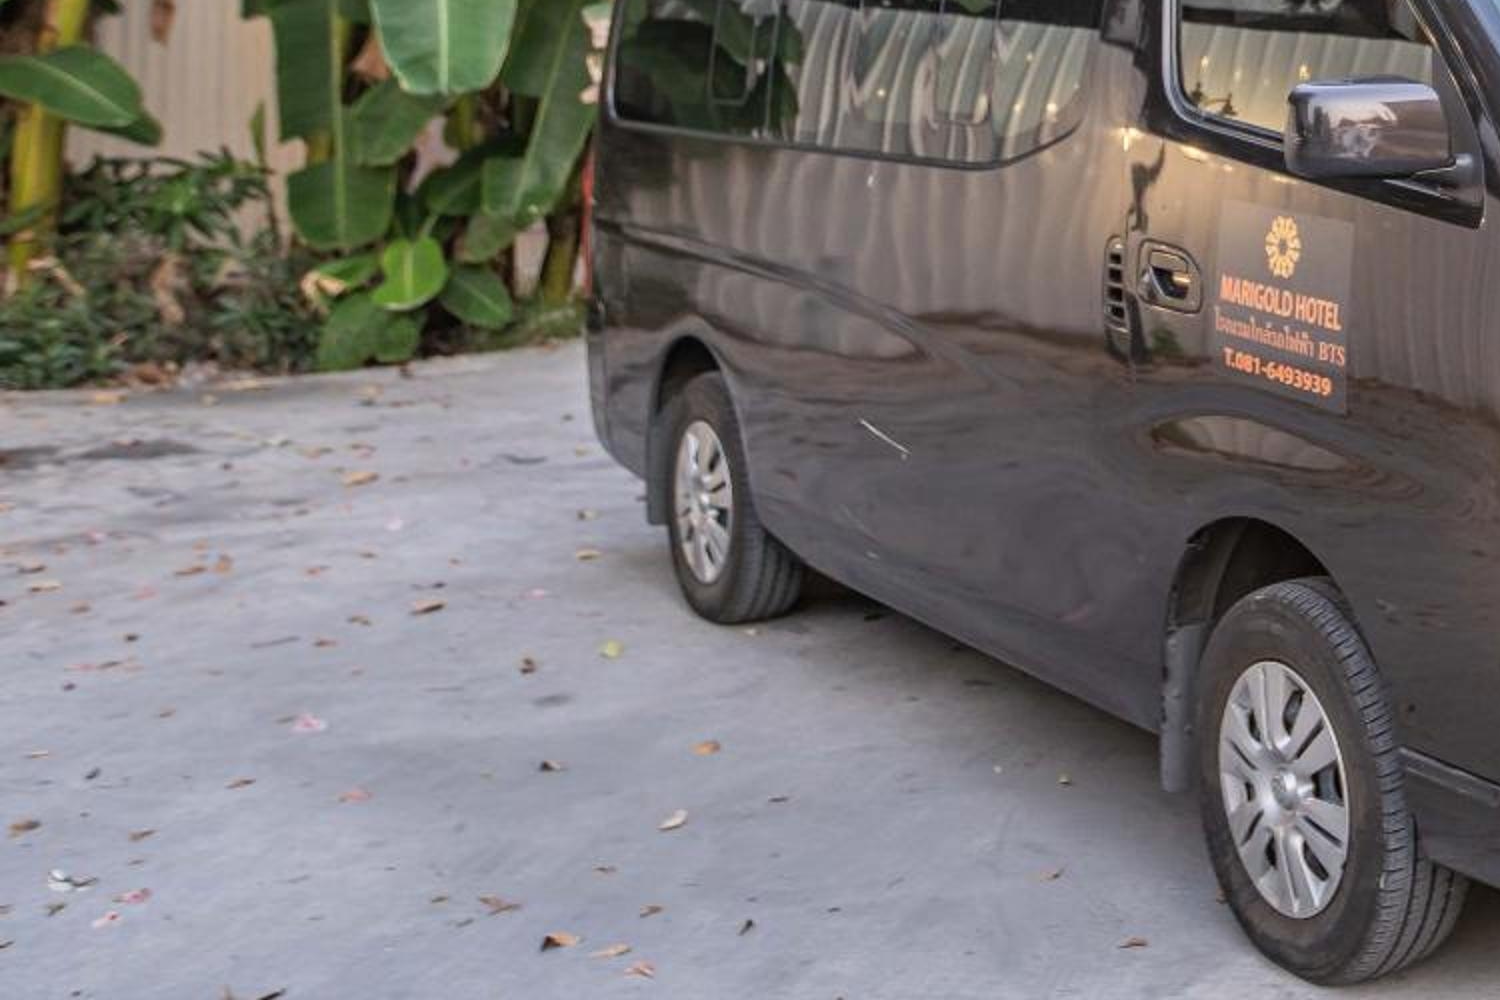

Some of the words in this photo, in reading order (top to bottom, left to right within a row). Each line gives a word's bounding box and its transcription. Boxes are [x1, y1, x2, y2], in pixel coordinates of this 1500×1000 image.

[1220, 275, 1292, 317] MARIGOLD
[1296, 295, 1342, 331] HOTEL
[1224, 347, 1332, 395] T.081-6493939
[1319, 340, 1346, 368] BTS
